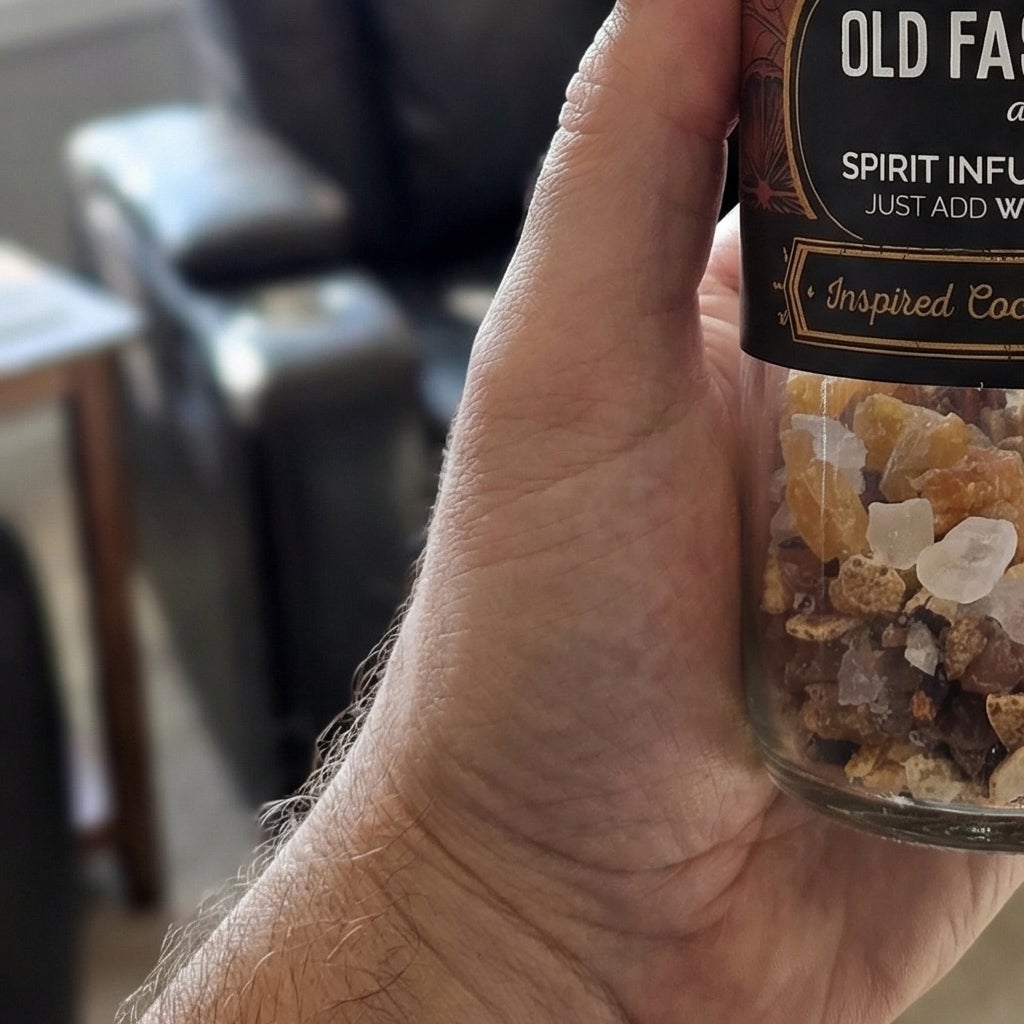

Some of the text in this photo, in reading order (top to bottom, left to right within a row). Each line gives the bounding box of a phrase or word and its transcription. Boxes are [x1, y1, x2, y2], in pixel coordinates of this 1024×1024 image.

[841, 9, 928, 78] OLD
[842, 151, 940, 184] SPIRIT
[865, 193, 926, 218] JUST
[930, 196, 988, 219] ADD
[825, 276, 955, 326] Inspired
